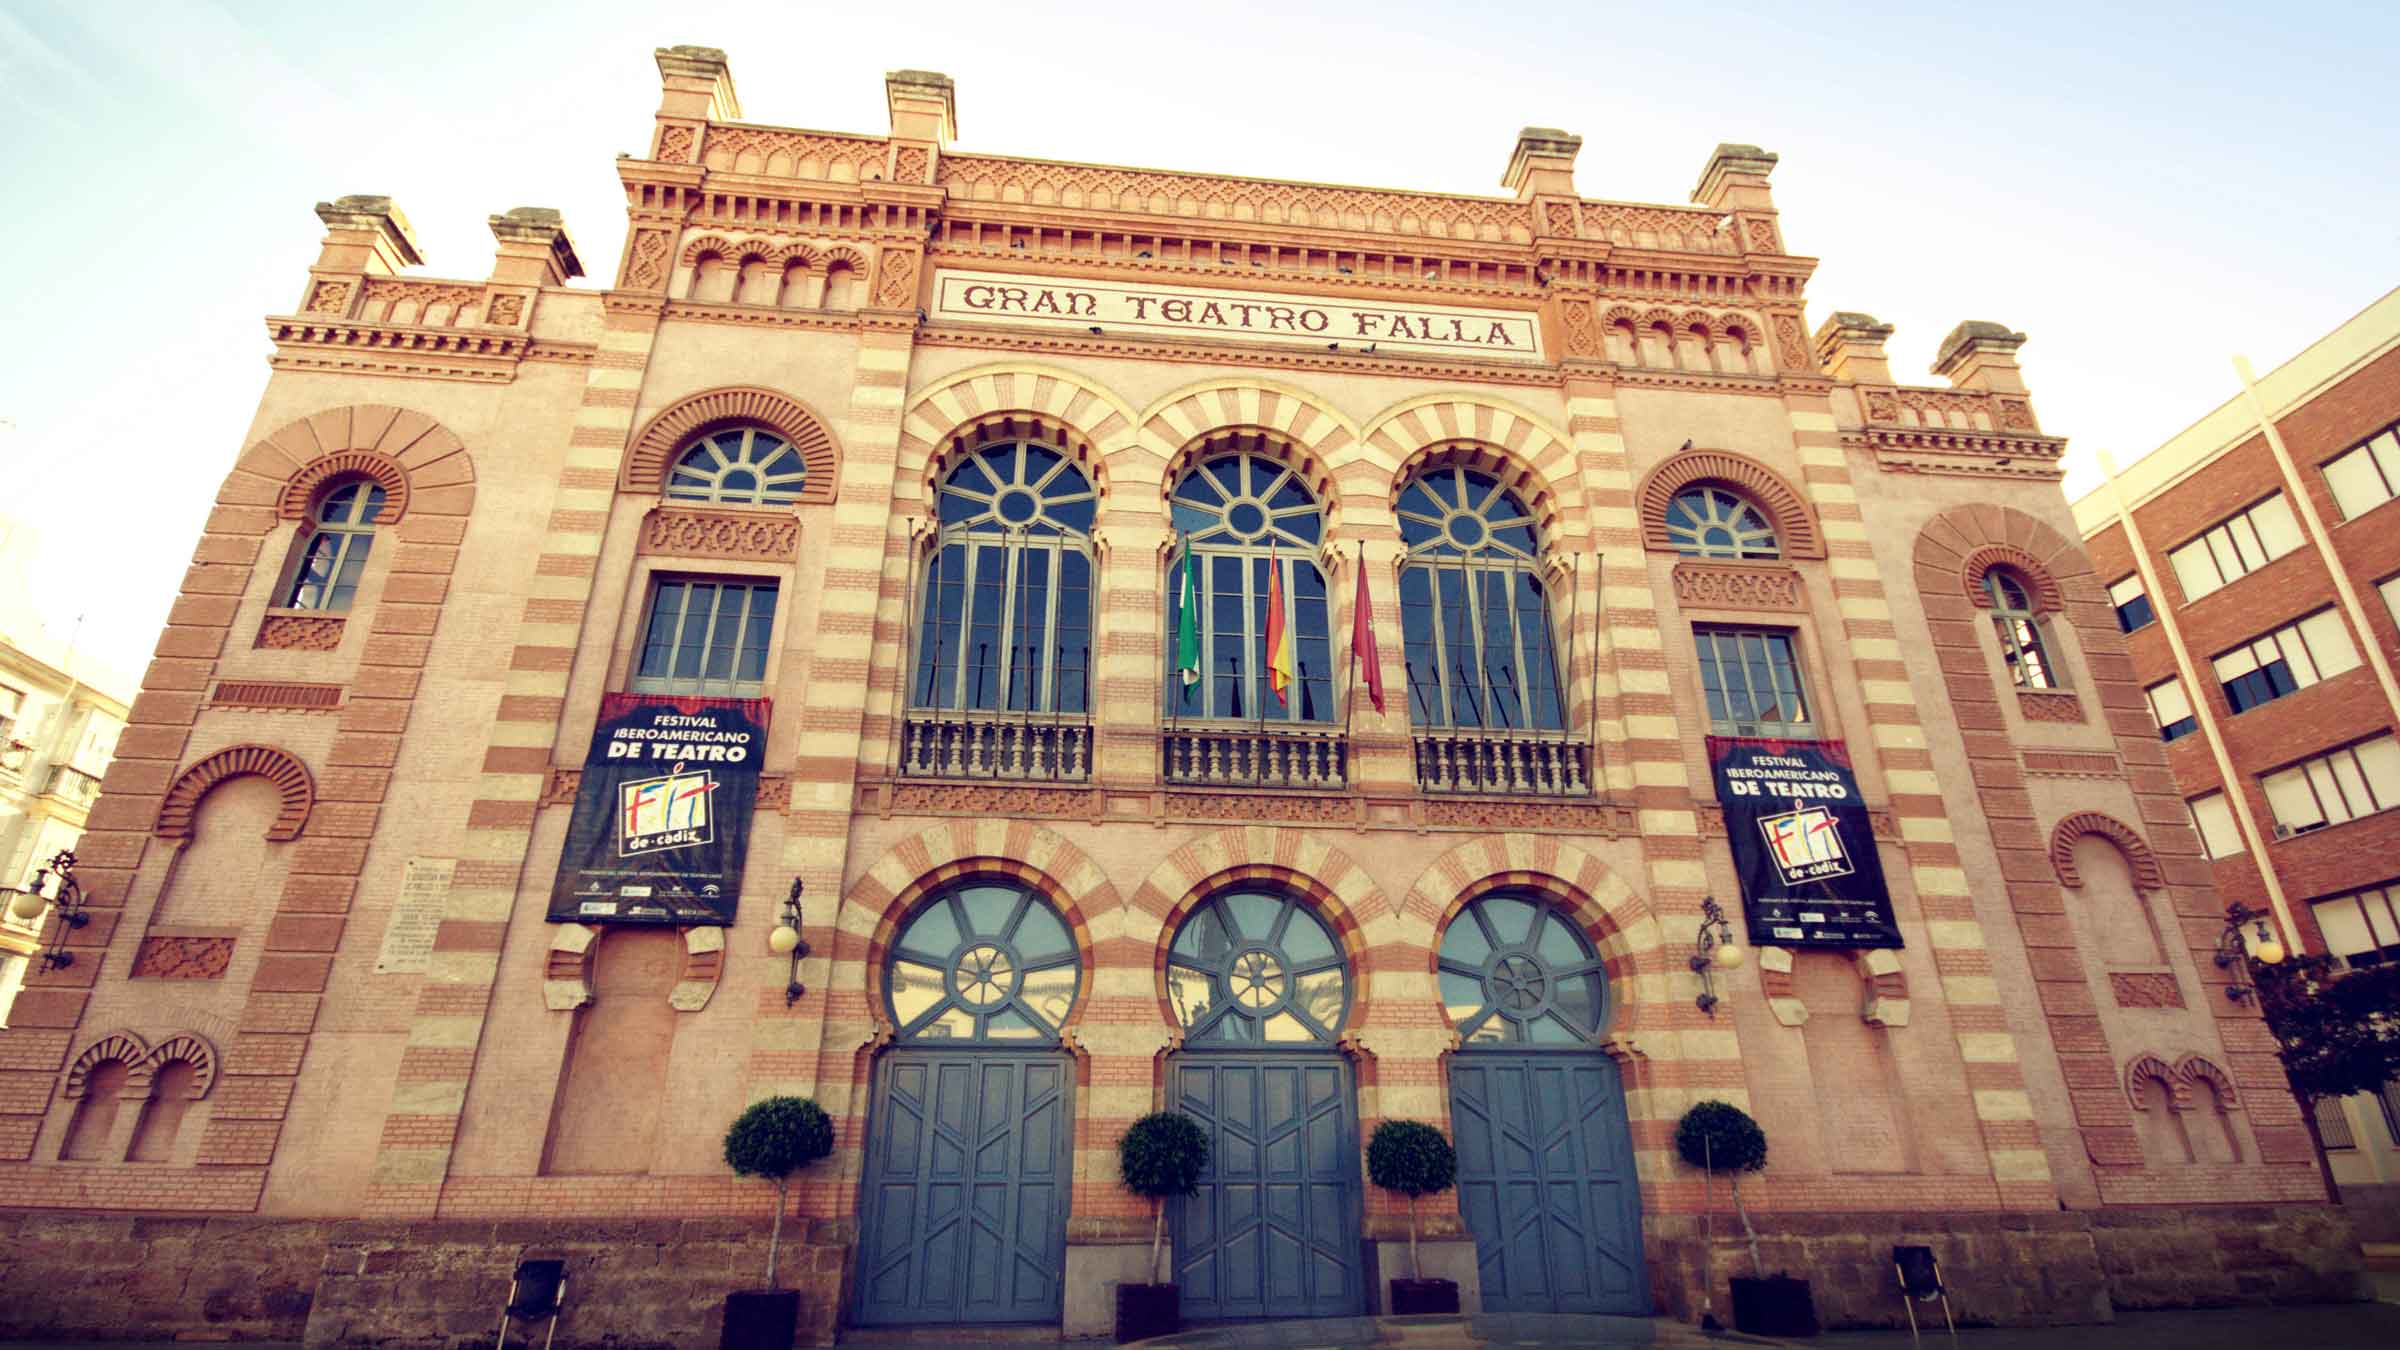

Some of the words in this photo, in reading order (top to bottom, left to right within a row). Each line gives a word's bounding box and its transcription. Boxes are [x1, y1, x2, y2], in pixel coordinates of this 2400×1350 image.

[962, 285, 1097, 316] GRAN
[1126, 296, 1329, 333] TEATRO
[1354, 312, 1516, 346] FALLA
[654, 715, 717, 728] FESTIVAL
[613, 728, 750, 744] IBEROAMERICANO
[607, 741, 642, 758] DE
[651, 743, 747, 762] TEATRO
[1752, 756, 1807, 768] FESTIVAL
[1726, 768, 1840, 782] IBEROAMERICANO
[1729, 780, 1761, 796] DE
[1764, 781, 1847, 799] TEATRO
